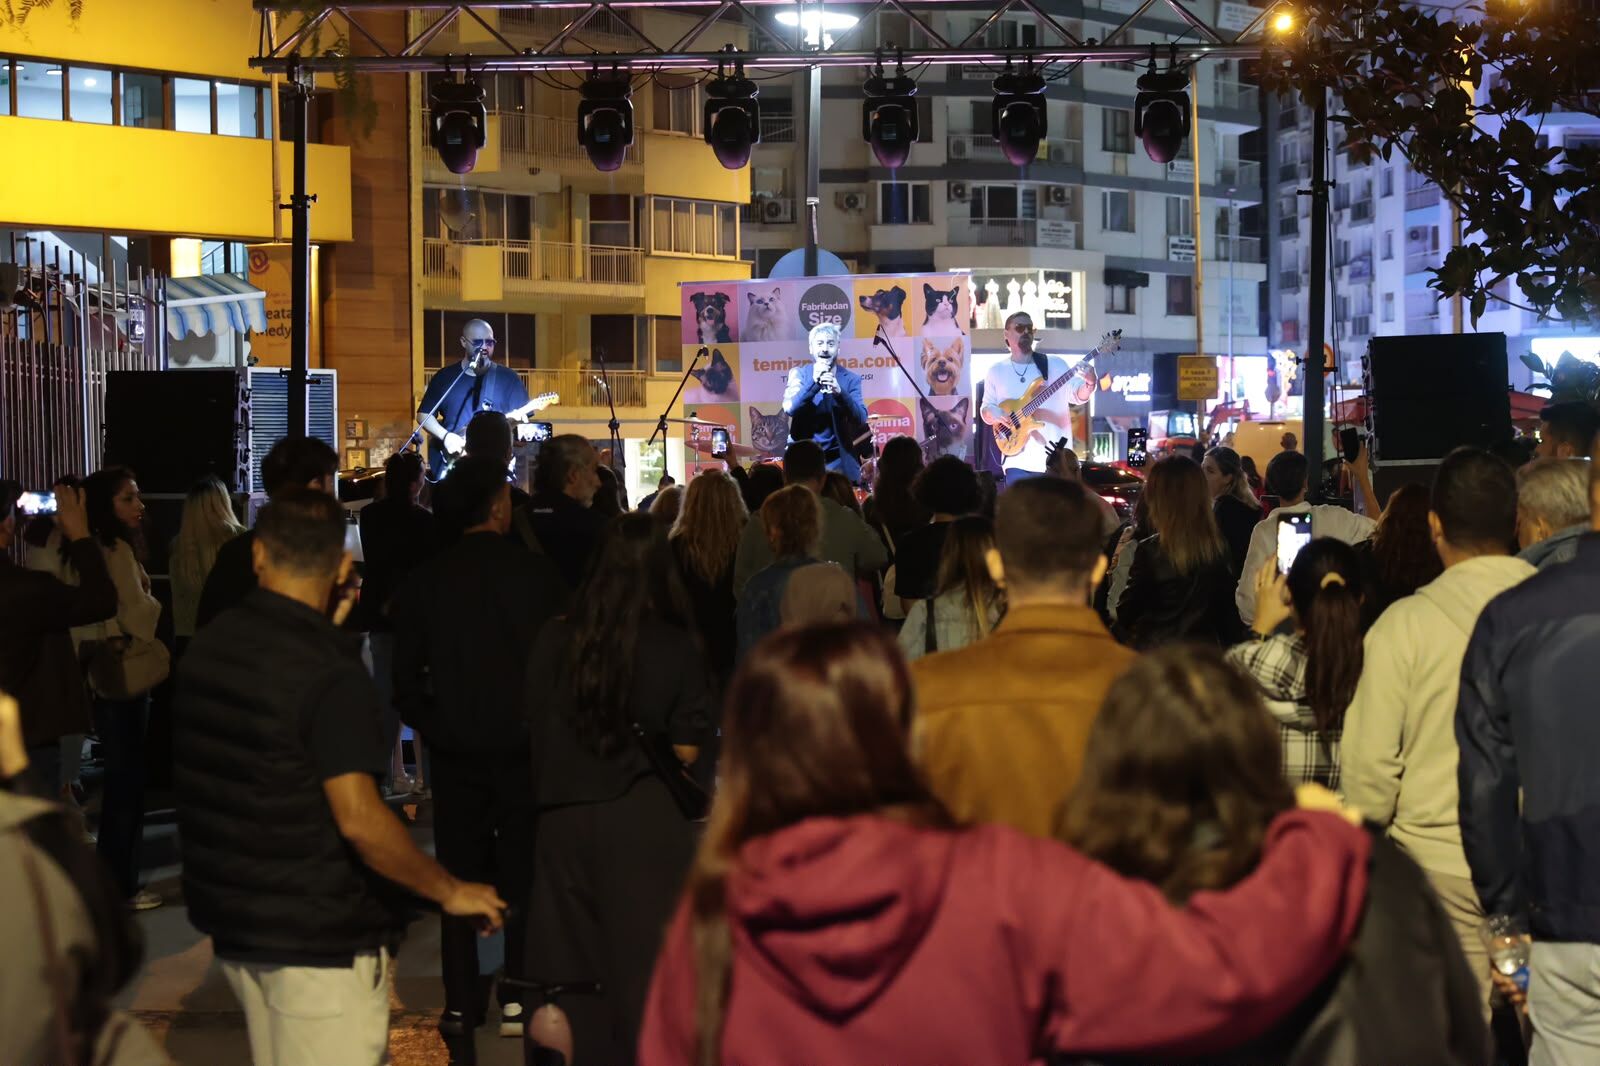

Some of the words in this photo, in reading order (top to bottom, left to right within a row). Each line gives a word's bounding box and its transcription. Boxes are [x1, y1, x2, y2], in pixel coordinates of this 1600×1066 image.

[801, 301, 849, 311] Fabrikadan
[808, 312, 842, 326] Size
[752, 355, 900, 372] temiza.com
